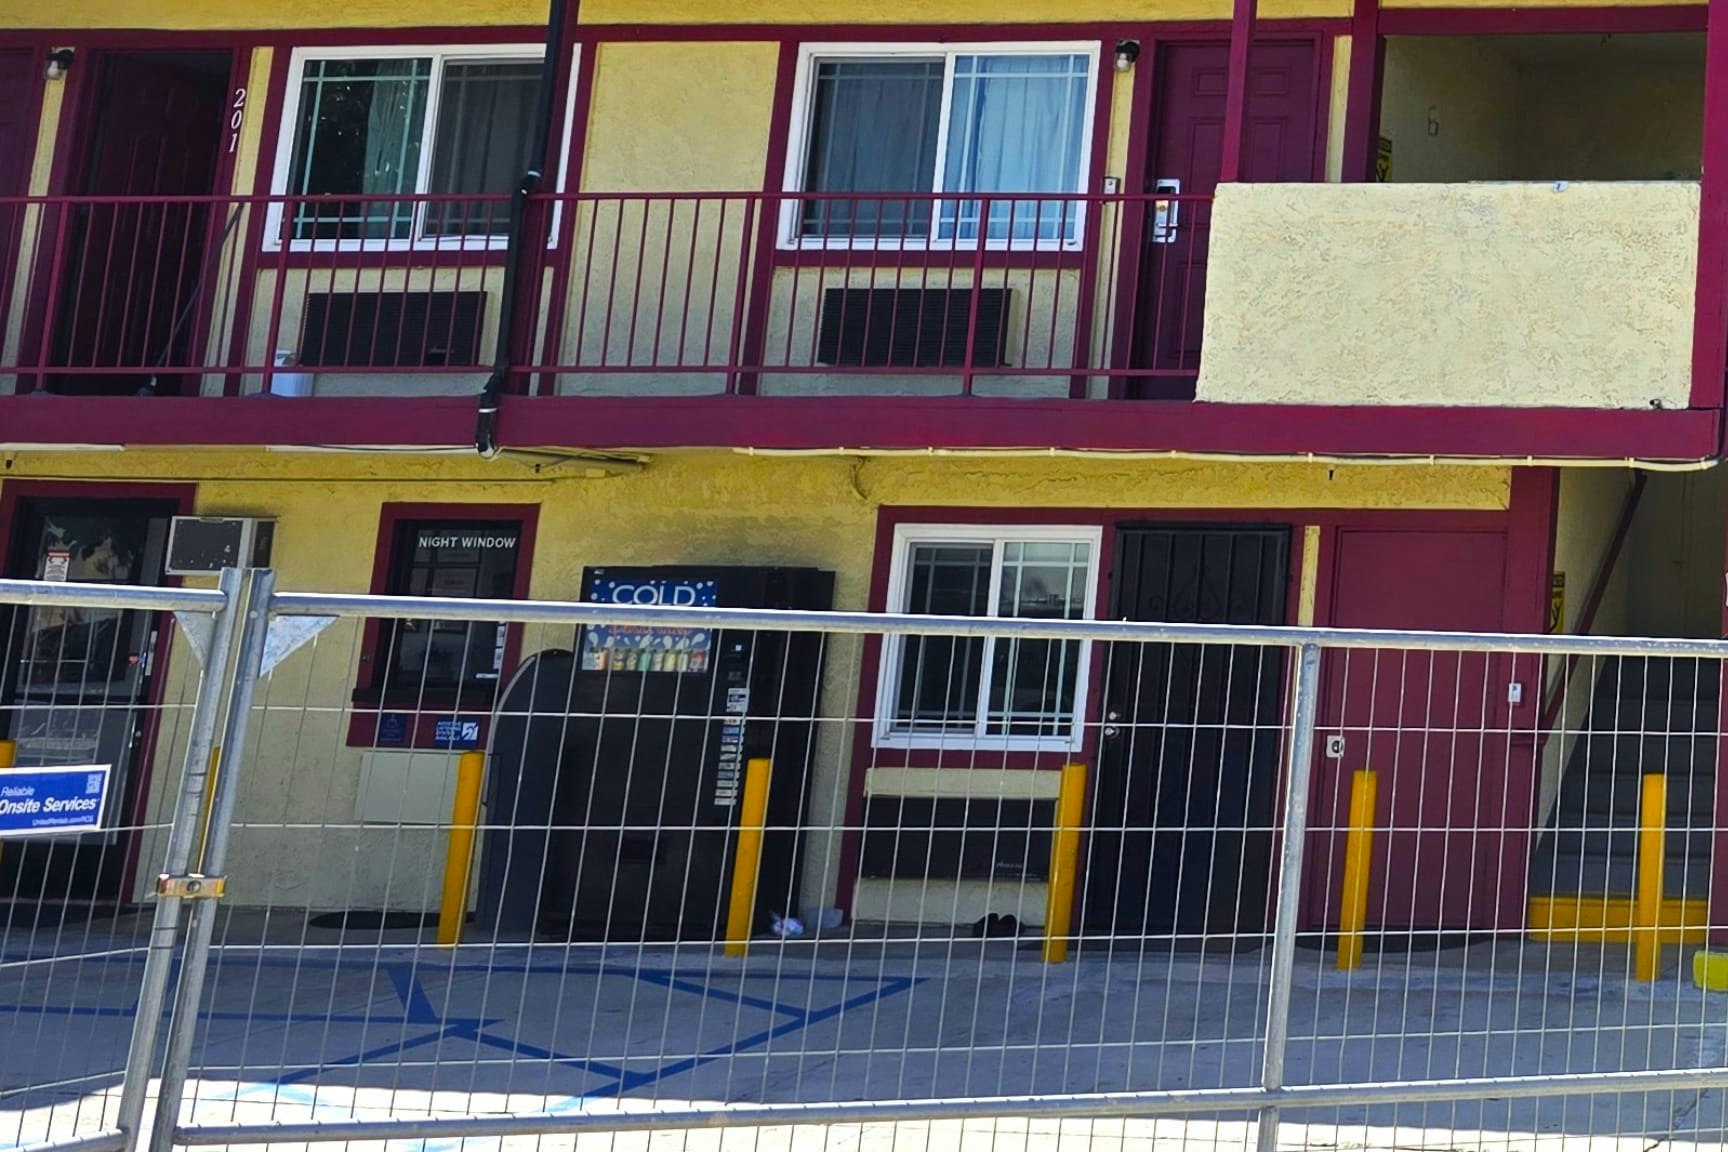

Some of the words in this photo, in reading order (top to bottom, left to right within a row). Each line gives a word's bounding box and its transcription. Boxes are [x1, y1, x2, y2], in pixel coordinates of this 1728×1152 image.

[229, 88, 246, 153] 201
[418, 536, 458, 549] NIGHT
[461, 536, 516, 549] WINDOW
[611, 584, 697, 607] COLD
[0, 798, 40, 815] Onsite
[42, 796, 97, 813] Services
